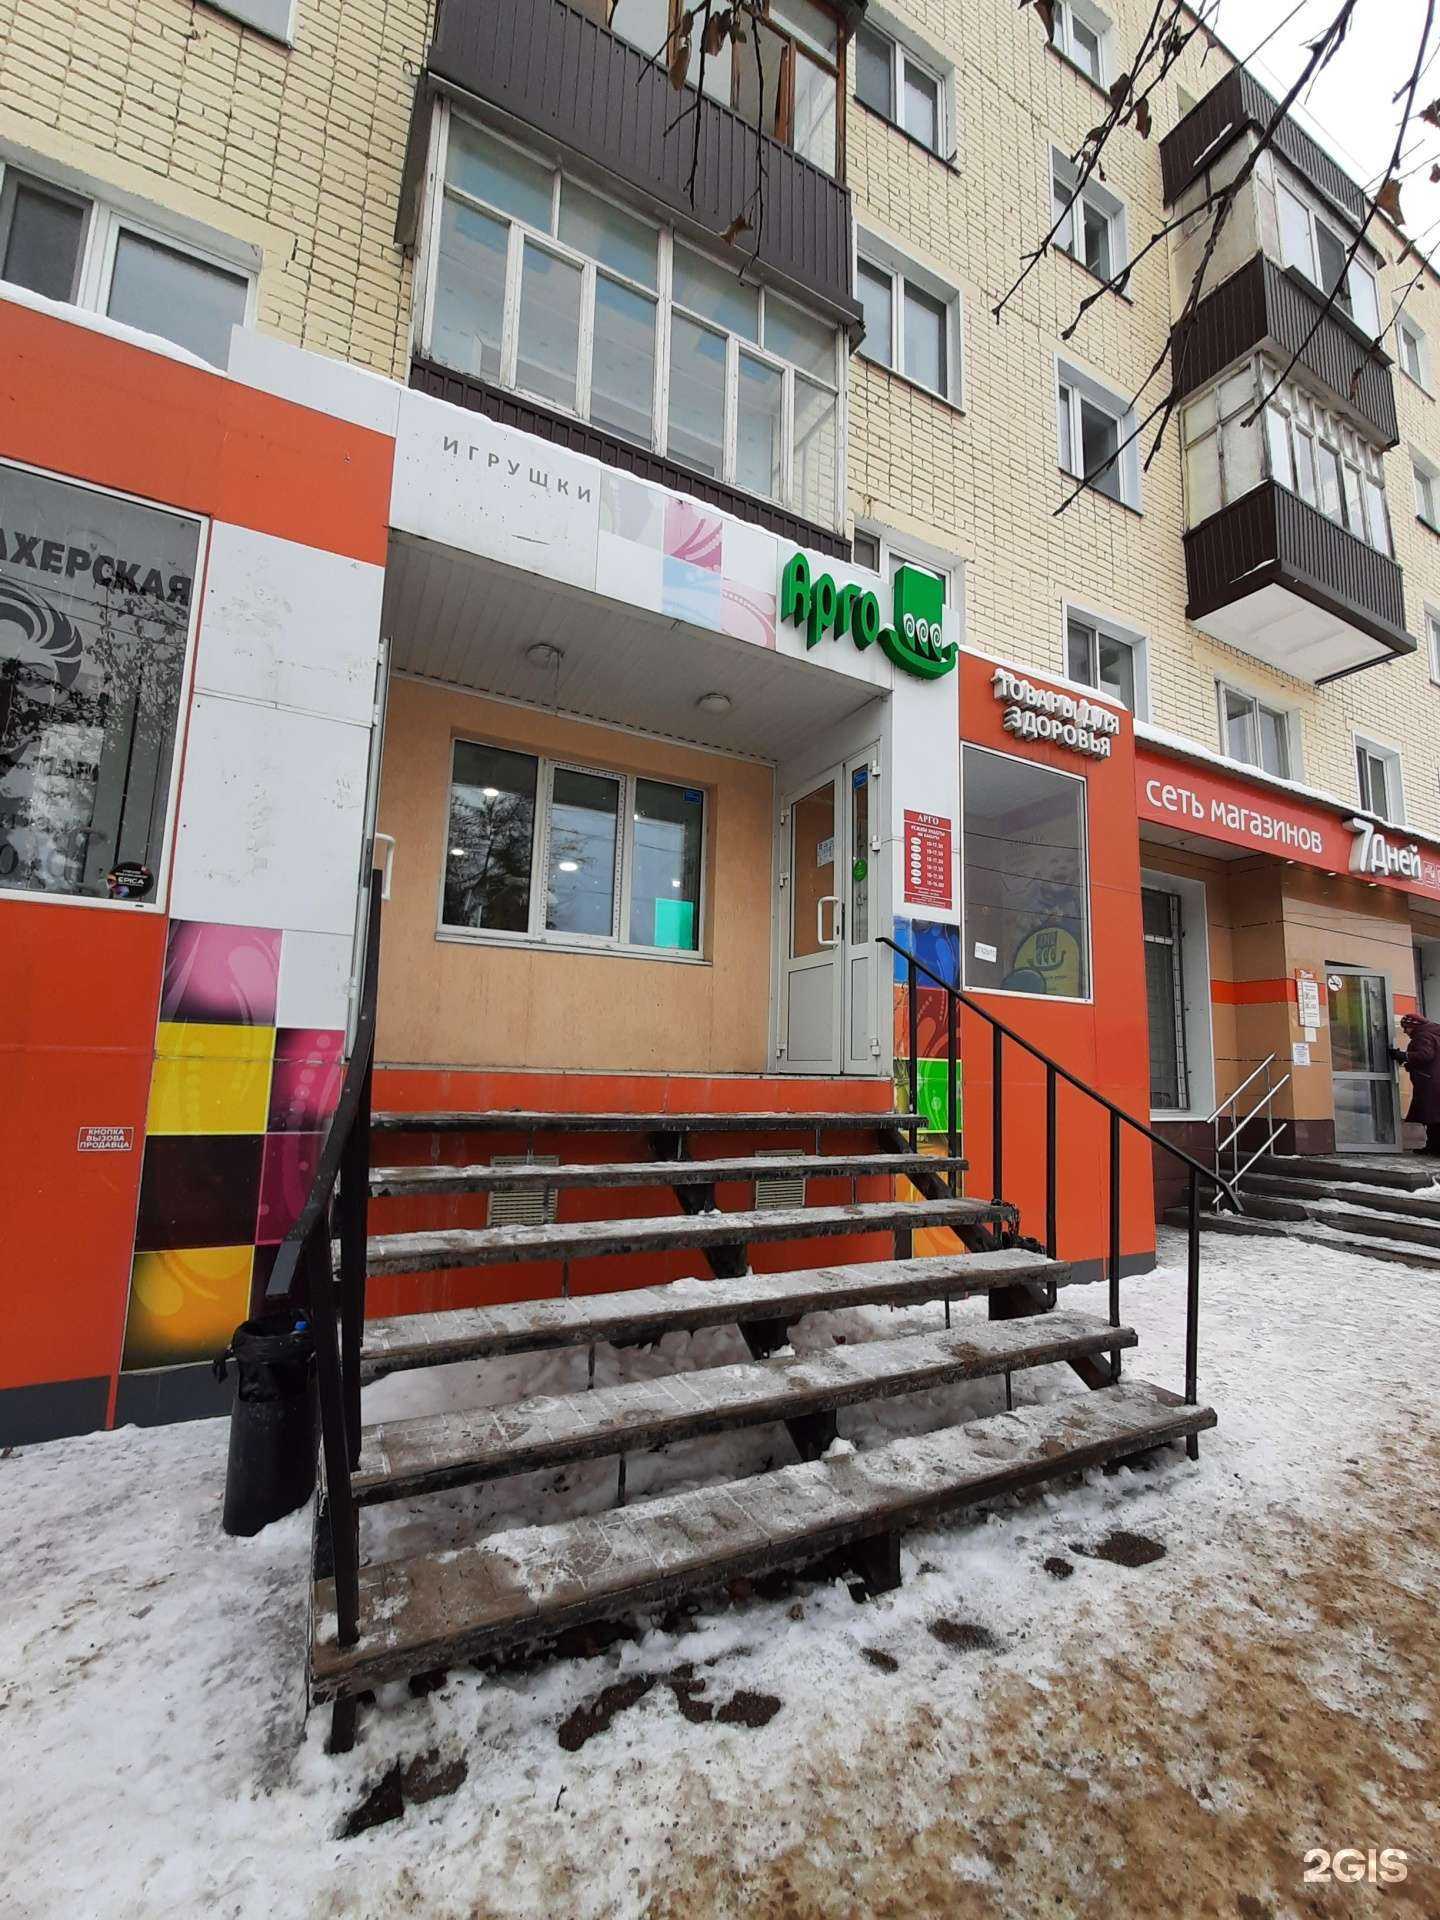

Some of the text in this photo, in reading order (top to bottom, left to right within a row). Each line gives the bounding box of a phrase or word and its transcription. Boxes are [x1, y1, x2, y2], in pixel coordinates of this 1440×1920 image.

[443, 436, 591, 503] ИГРУШКИ
[991, 671, 1120, 735] ТОВАРЫ ДЛЯ
[1003, 706, 1111, 759] ЗДОРОВЬЯ
[80, 1141, 130, 1149] ПРОДАВЦА
